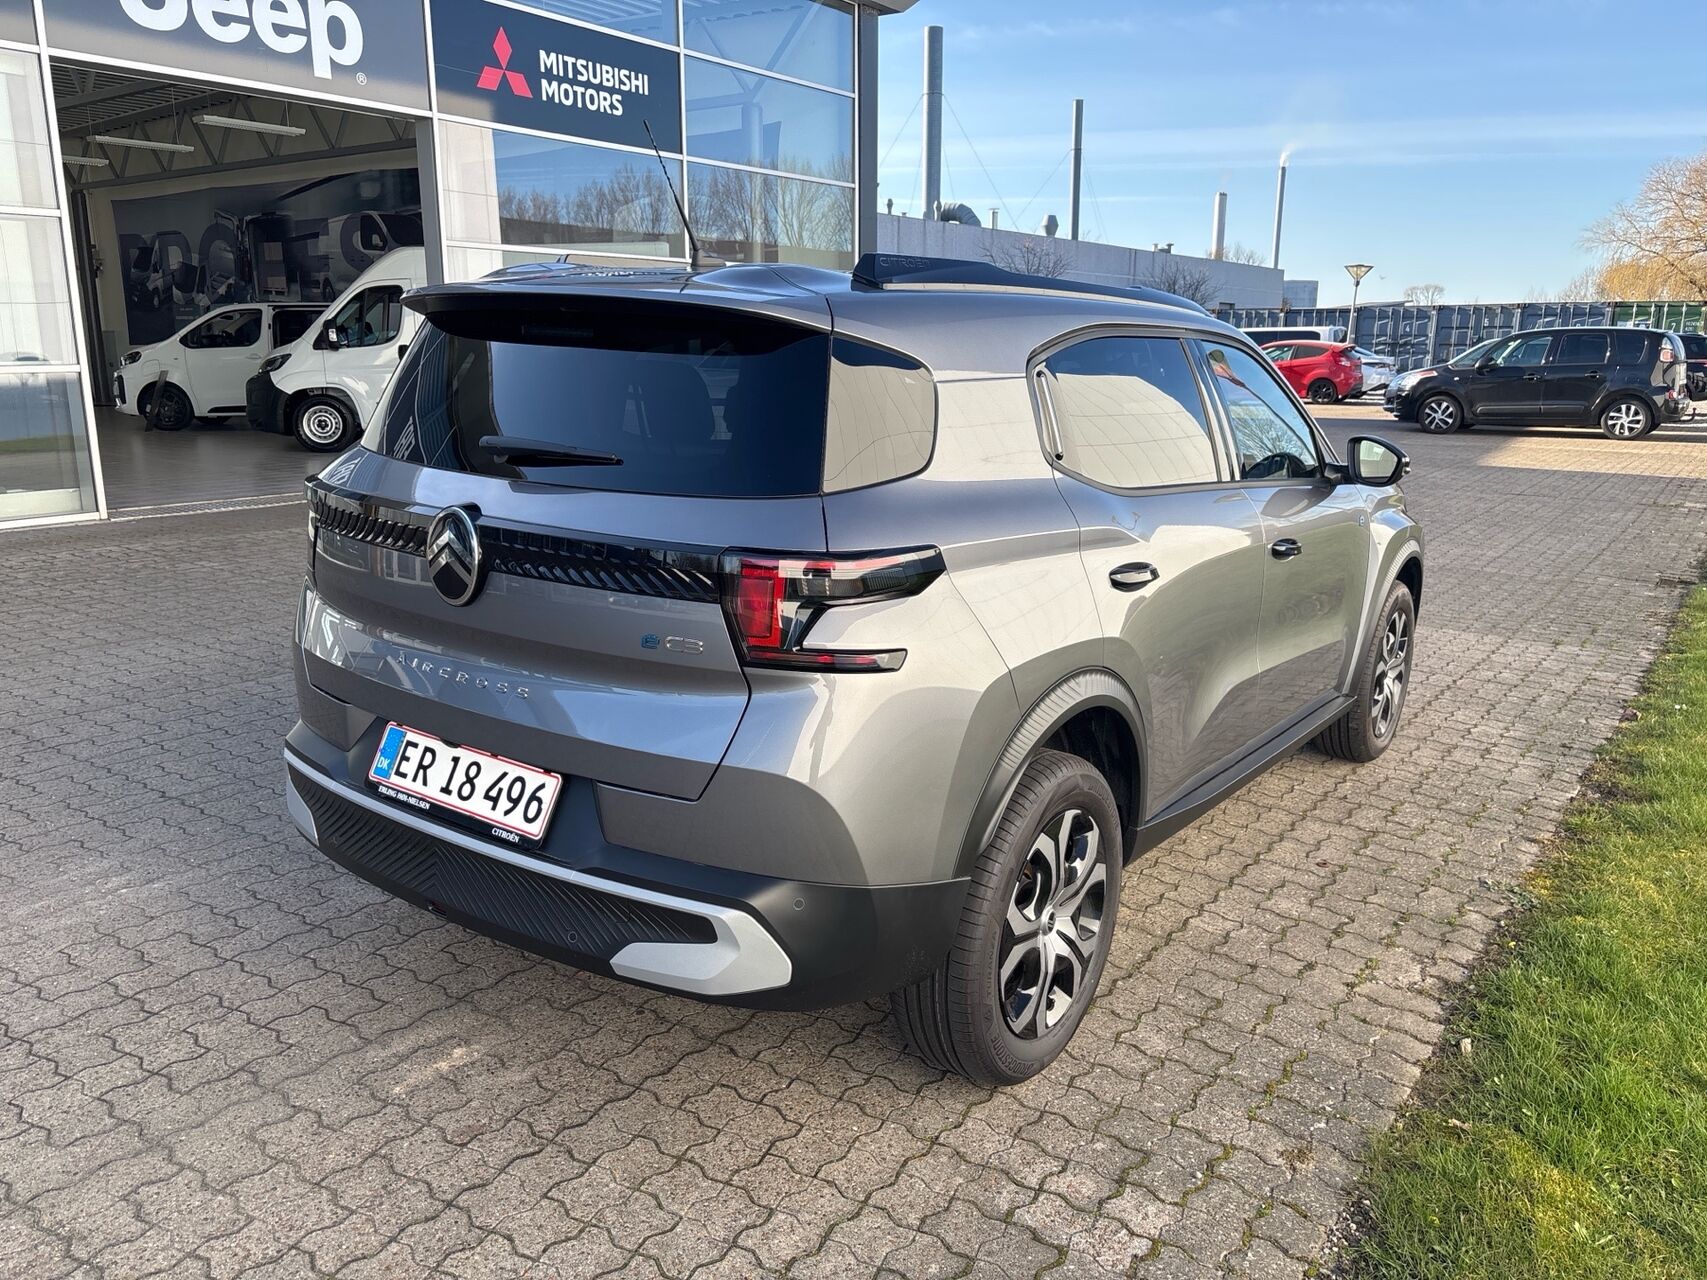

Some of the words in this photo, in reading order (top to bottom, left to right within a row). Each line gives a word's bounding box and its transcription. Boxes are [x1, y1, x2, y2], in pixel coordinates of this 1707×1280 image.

[539, 49, 649, 96] MITSUBISHI
[541, 78, 623, 116] MOTORS
[1483, 315, 1490, 327] 5
[1671, 322, 1677, 333] 7
[1404, 324, 1411, 333] 4
[396, 652, 529, 700] AIRCROSS
[377, 756, 391, 770] DK
[394, 740, 437, 787] ER
[439, 755, 482, 802] 18
[483, 771, 546, 824] 496
[378, 785, 398, 799] ERLING
